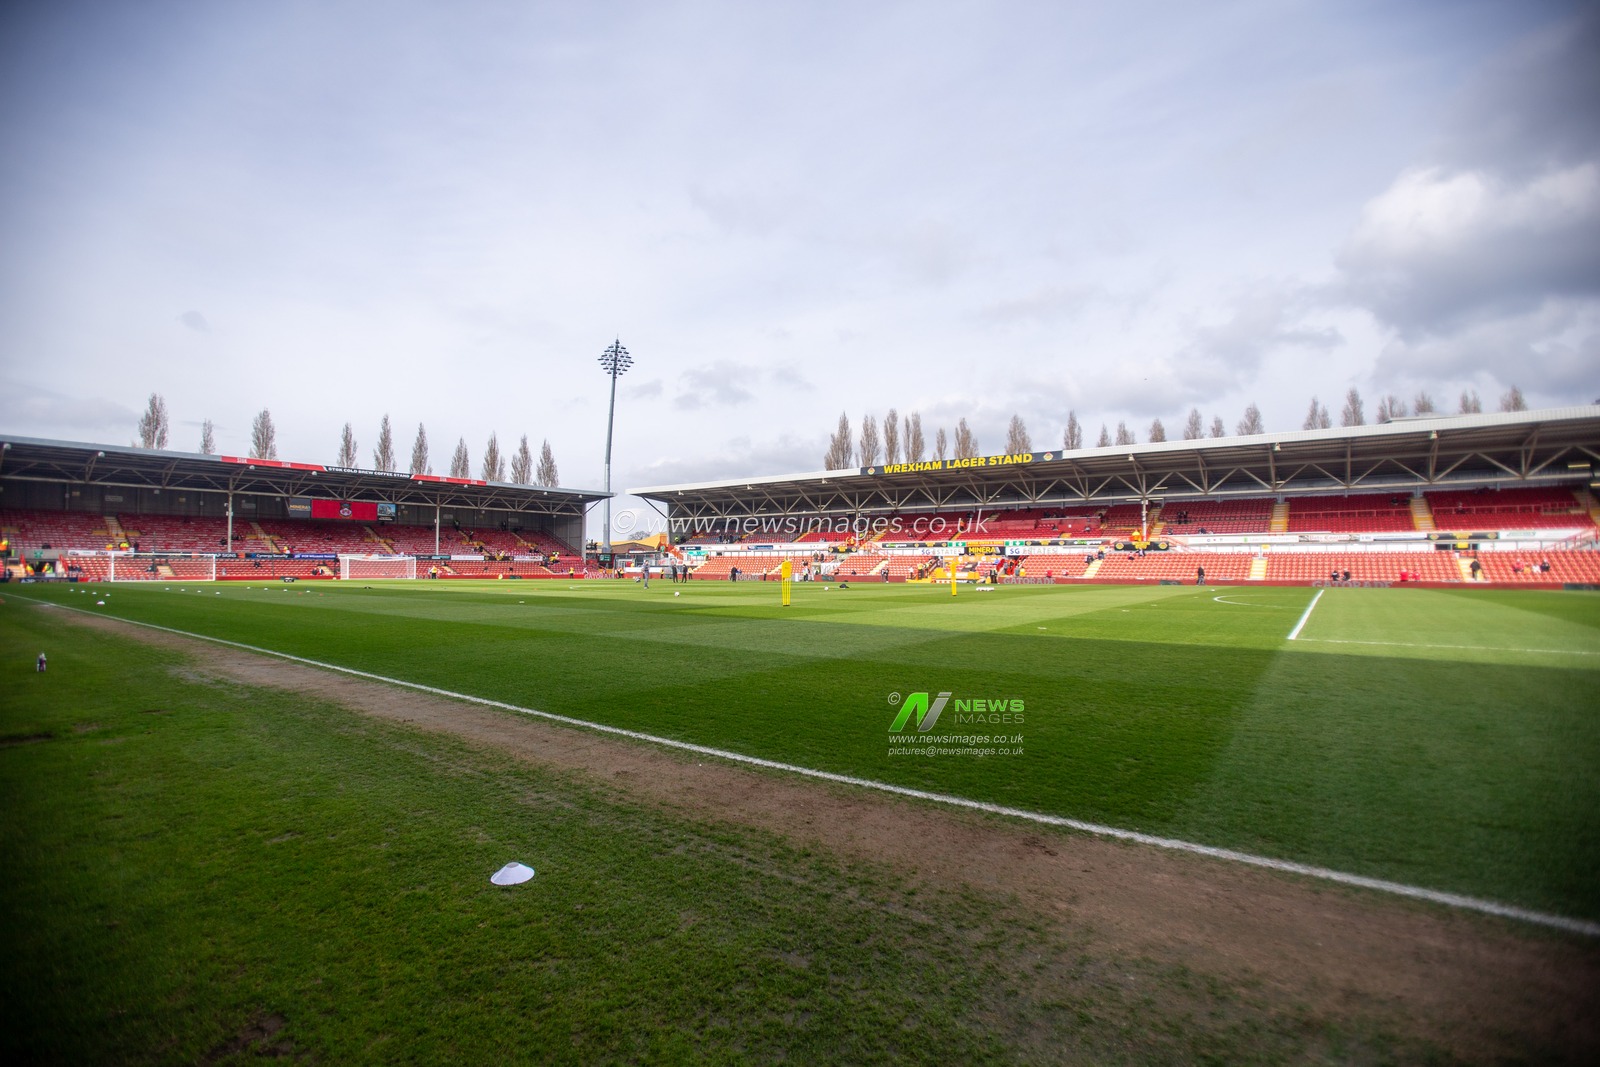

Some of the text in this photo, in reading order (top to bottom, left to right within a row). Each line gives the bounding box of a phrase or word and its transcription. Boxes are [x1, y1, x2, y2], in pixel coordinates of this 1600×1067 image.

[884, 453, 1033, 474] WREXHAM LAGER STAND
[968, 546, 995, 554] MINERA
[1003, 577, 1056, 585] GATORADE
